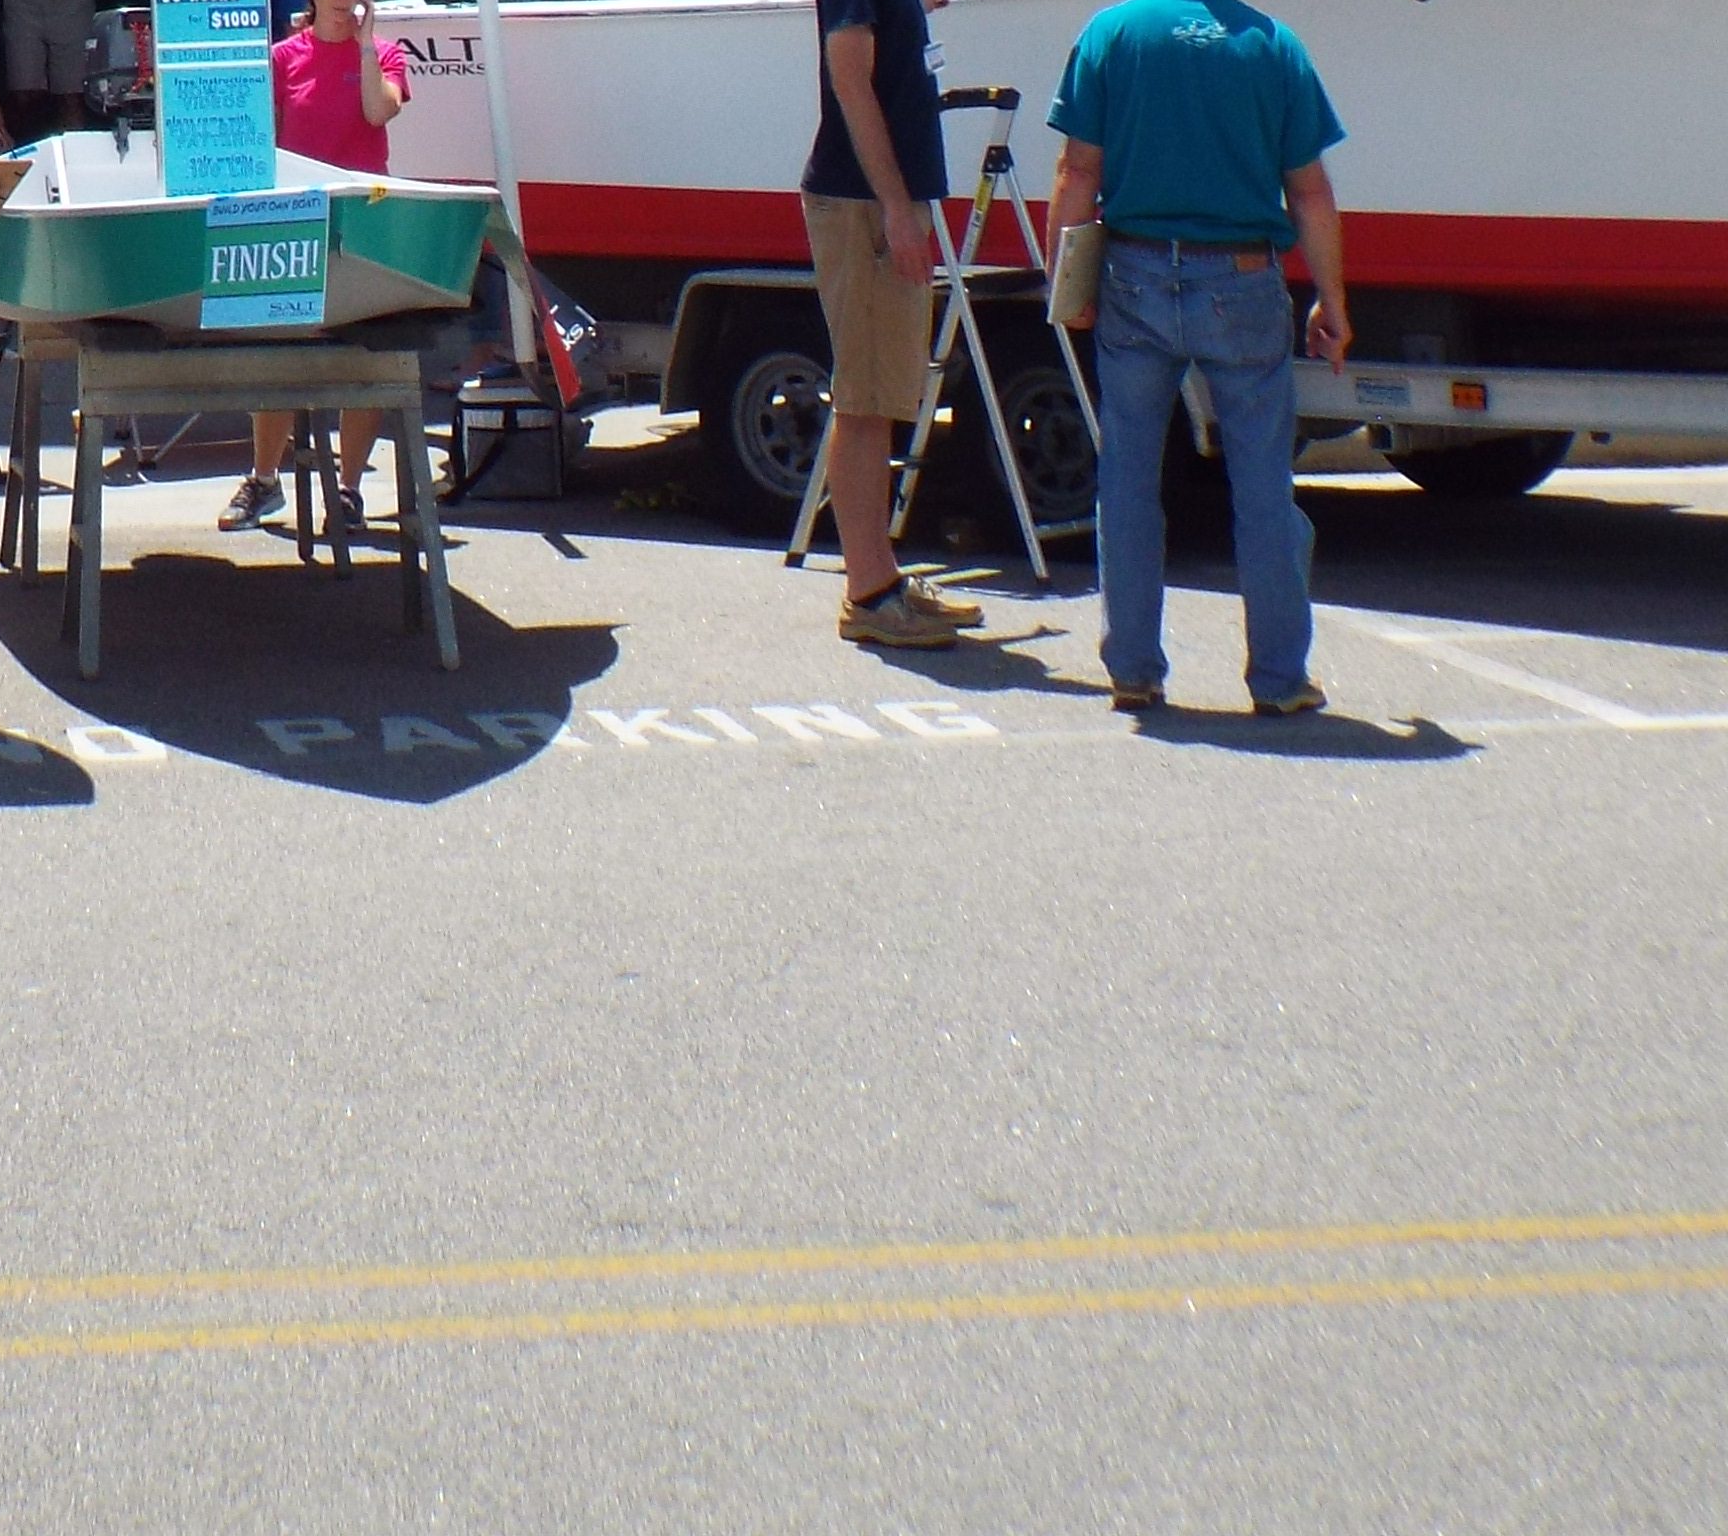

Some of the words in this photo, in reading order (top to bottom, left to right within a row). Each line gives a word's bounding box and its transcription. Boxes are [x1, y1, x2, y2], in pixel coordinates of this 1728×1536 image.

[212, 10, 259, 28] $1000
[396, 36, 482, 62] ALT
[406, 63, 485, 76] WORKS
[211, 239, 319, 283] FINISH!
[270, 301, 315, 312] SALT
[255, 699, 1001, 755] PARKING
